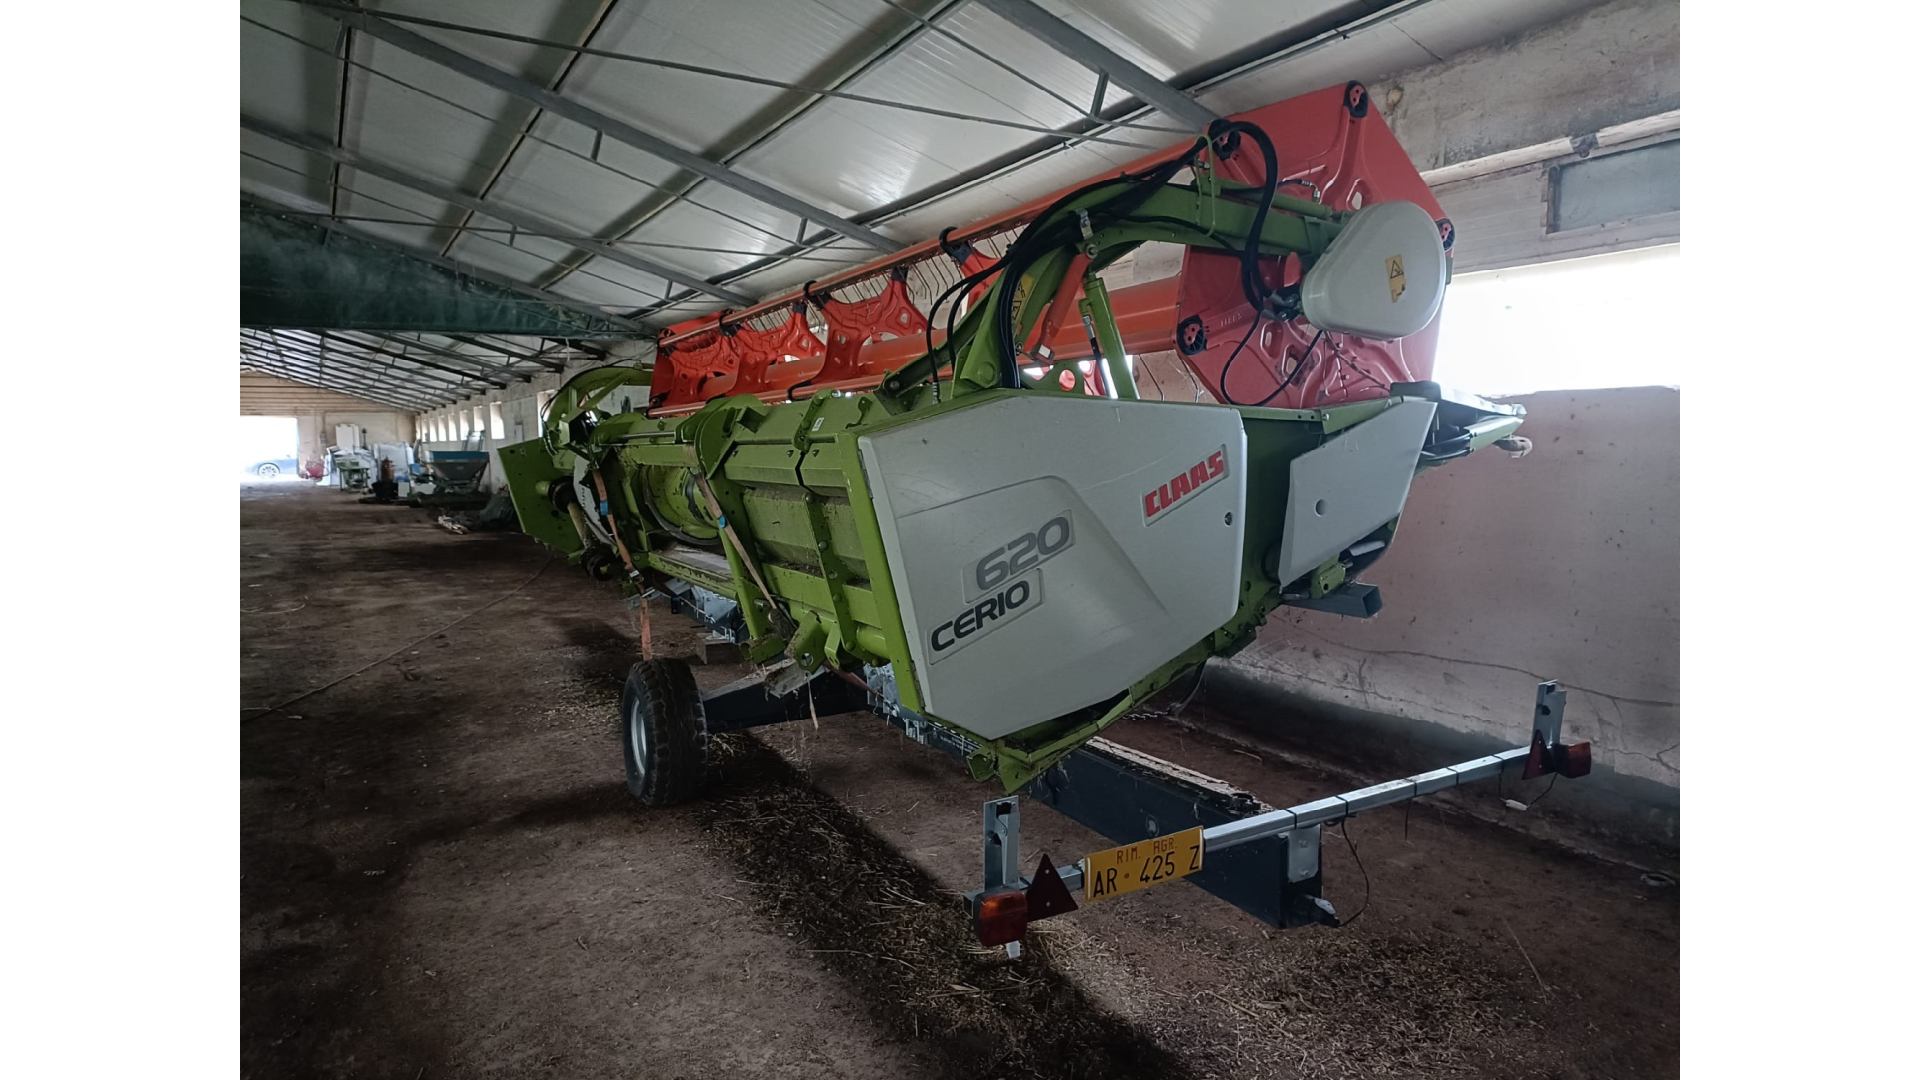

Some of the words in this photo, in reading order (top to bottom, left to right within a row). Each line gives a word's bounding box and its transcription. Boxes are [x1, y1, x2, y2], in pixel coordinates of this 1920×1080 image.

[1145, 450, 1224, 517] CLAAS
[976, 516, 1070, 591] 620
[931, 580, 1030, 652] CERIO
[1093, 867, 1118, 898] AR
[1139, 850, 1175, 883] 425
[1189, 845, 1200, 871] Z
